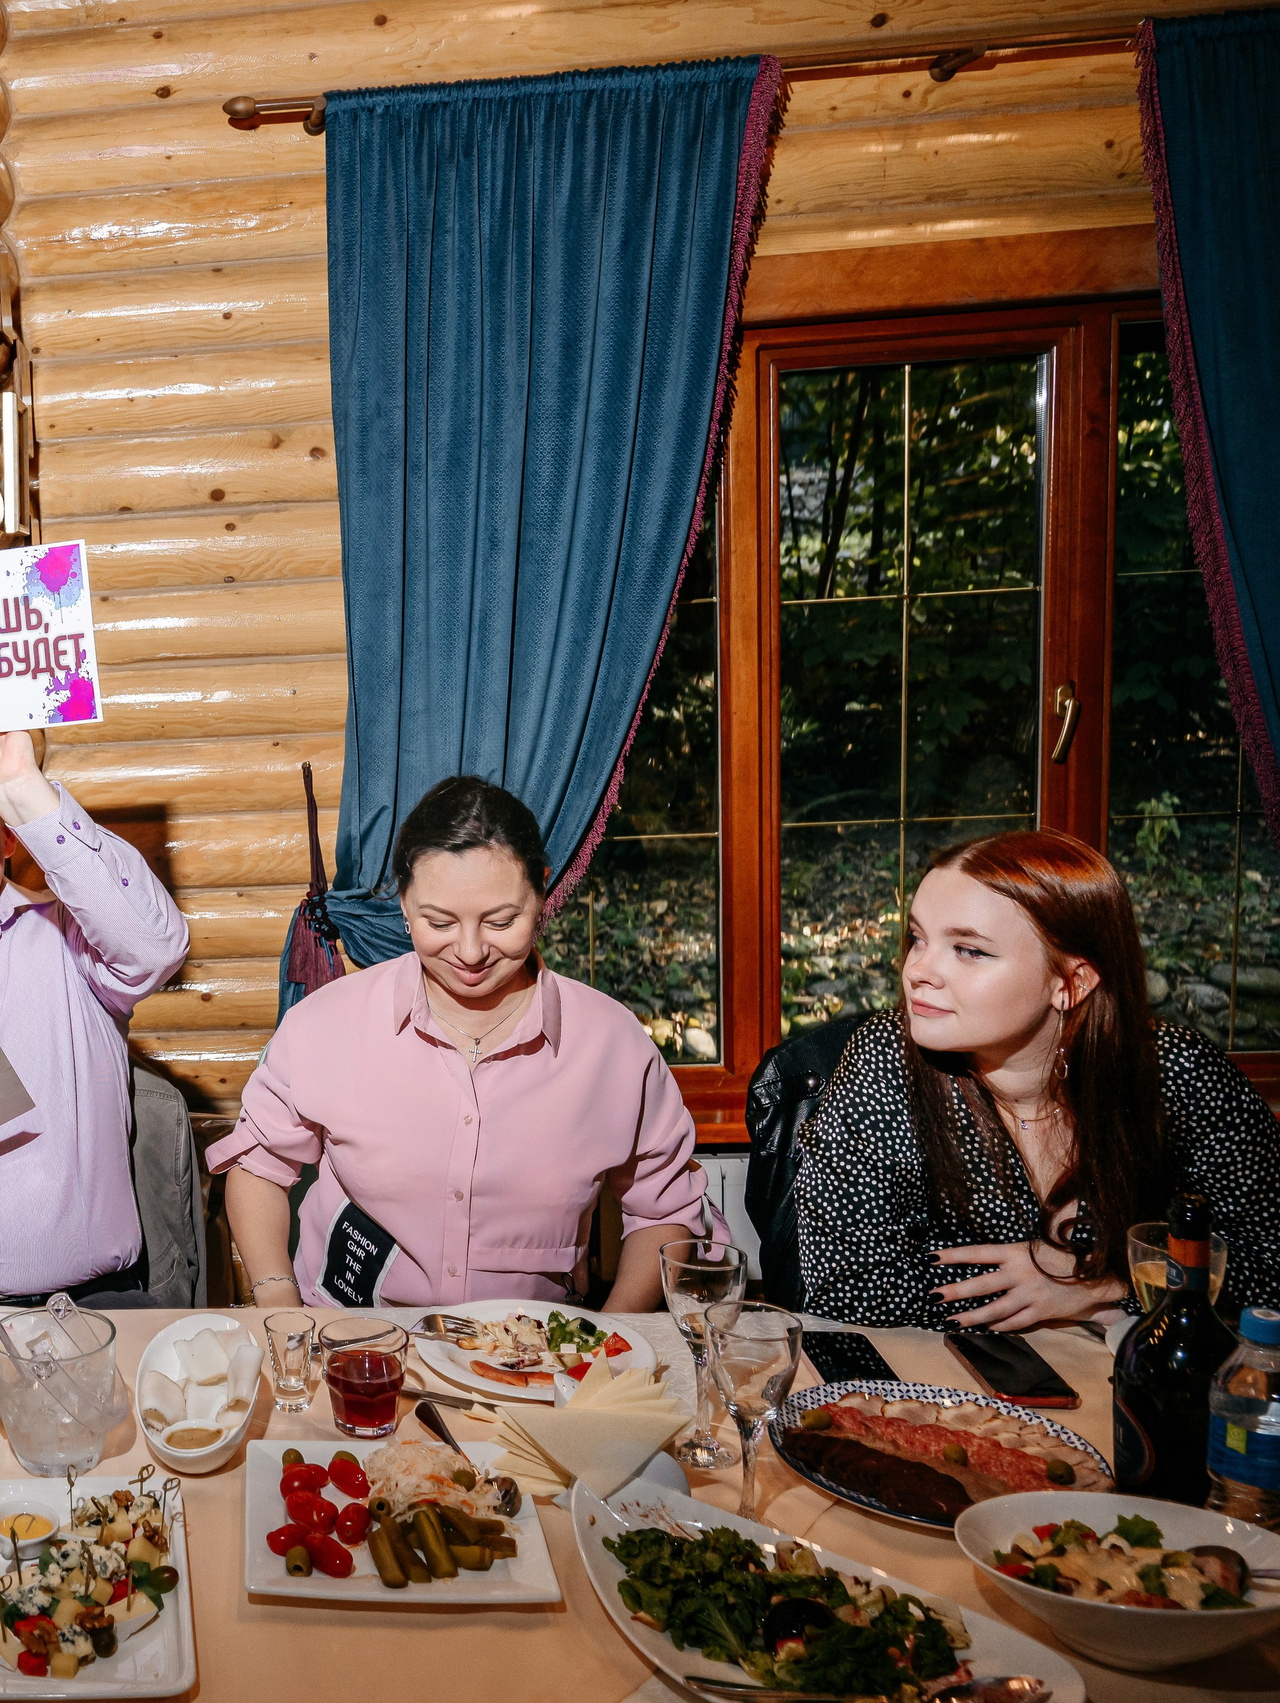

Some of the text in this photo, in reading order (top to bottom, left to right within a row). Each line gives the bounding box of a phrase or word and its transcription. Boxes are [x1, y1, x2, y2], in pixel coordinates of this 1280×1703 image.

[342, 1221, 378, 1256] FASHION
[347, 1240, 366, 1260] GHR
[345, 1254, 362, 1274] THE
[345, 1271, 355, 1284] IN
[333, 1275, 364, 1304] LOVELY
